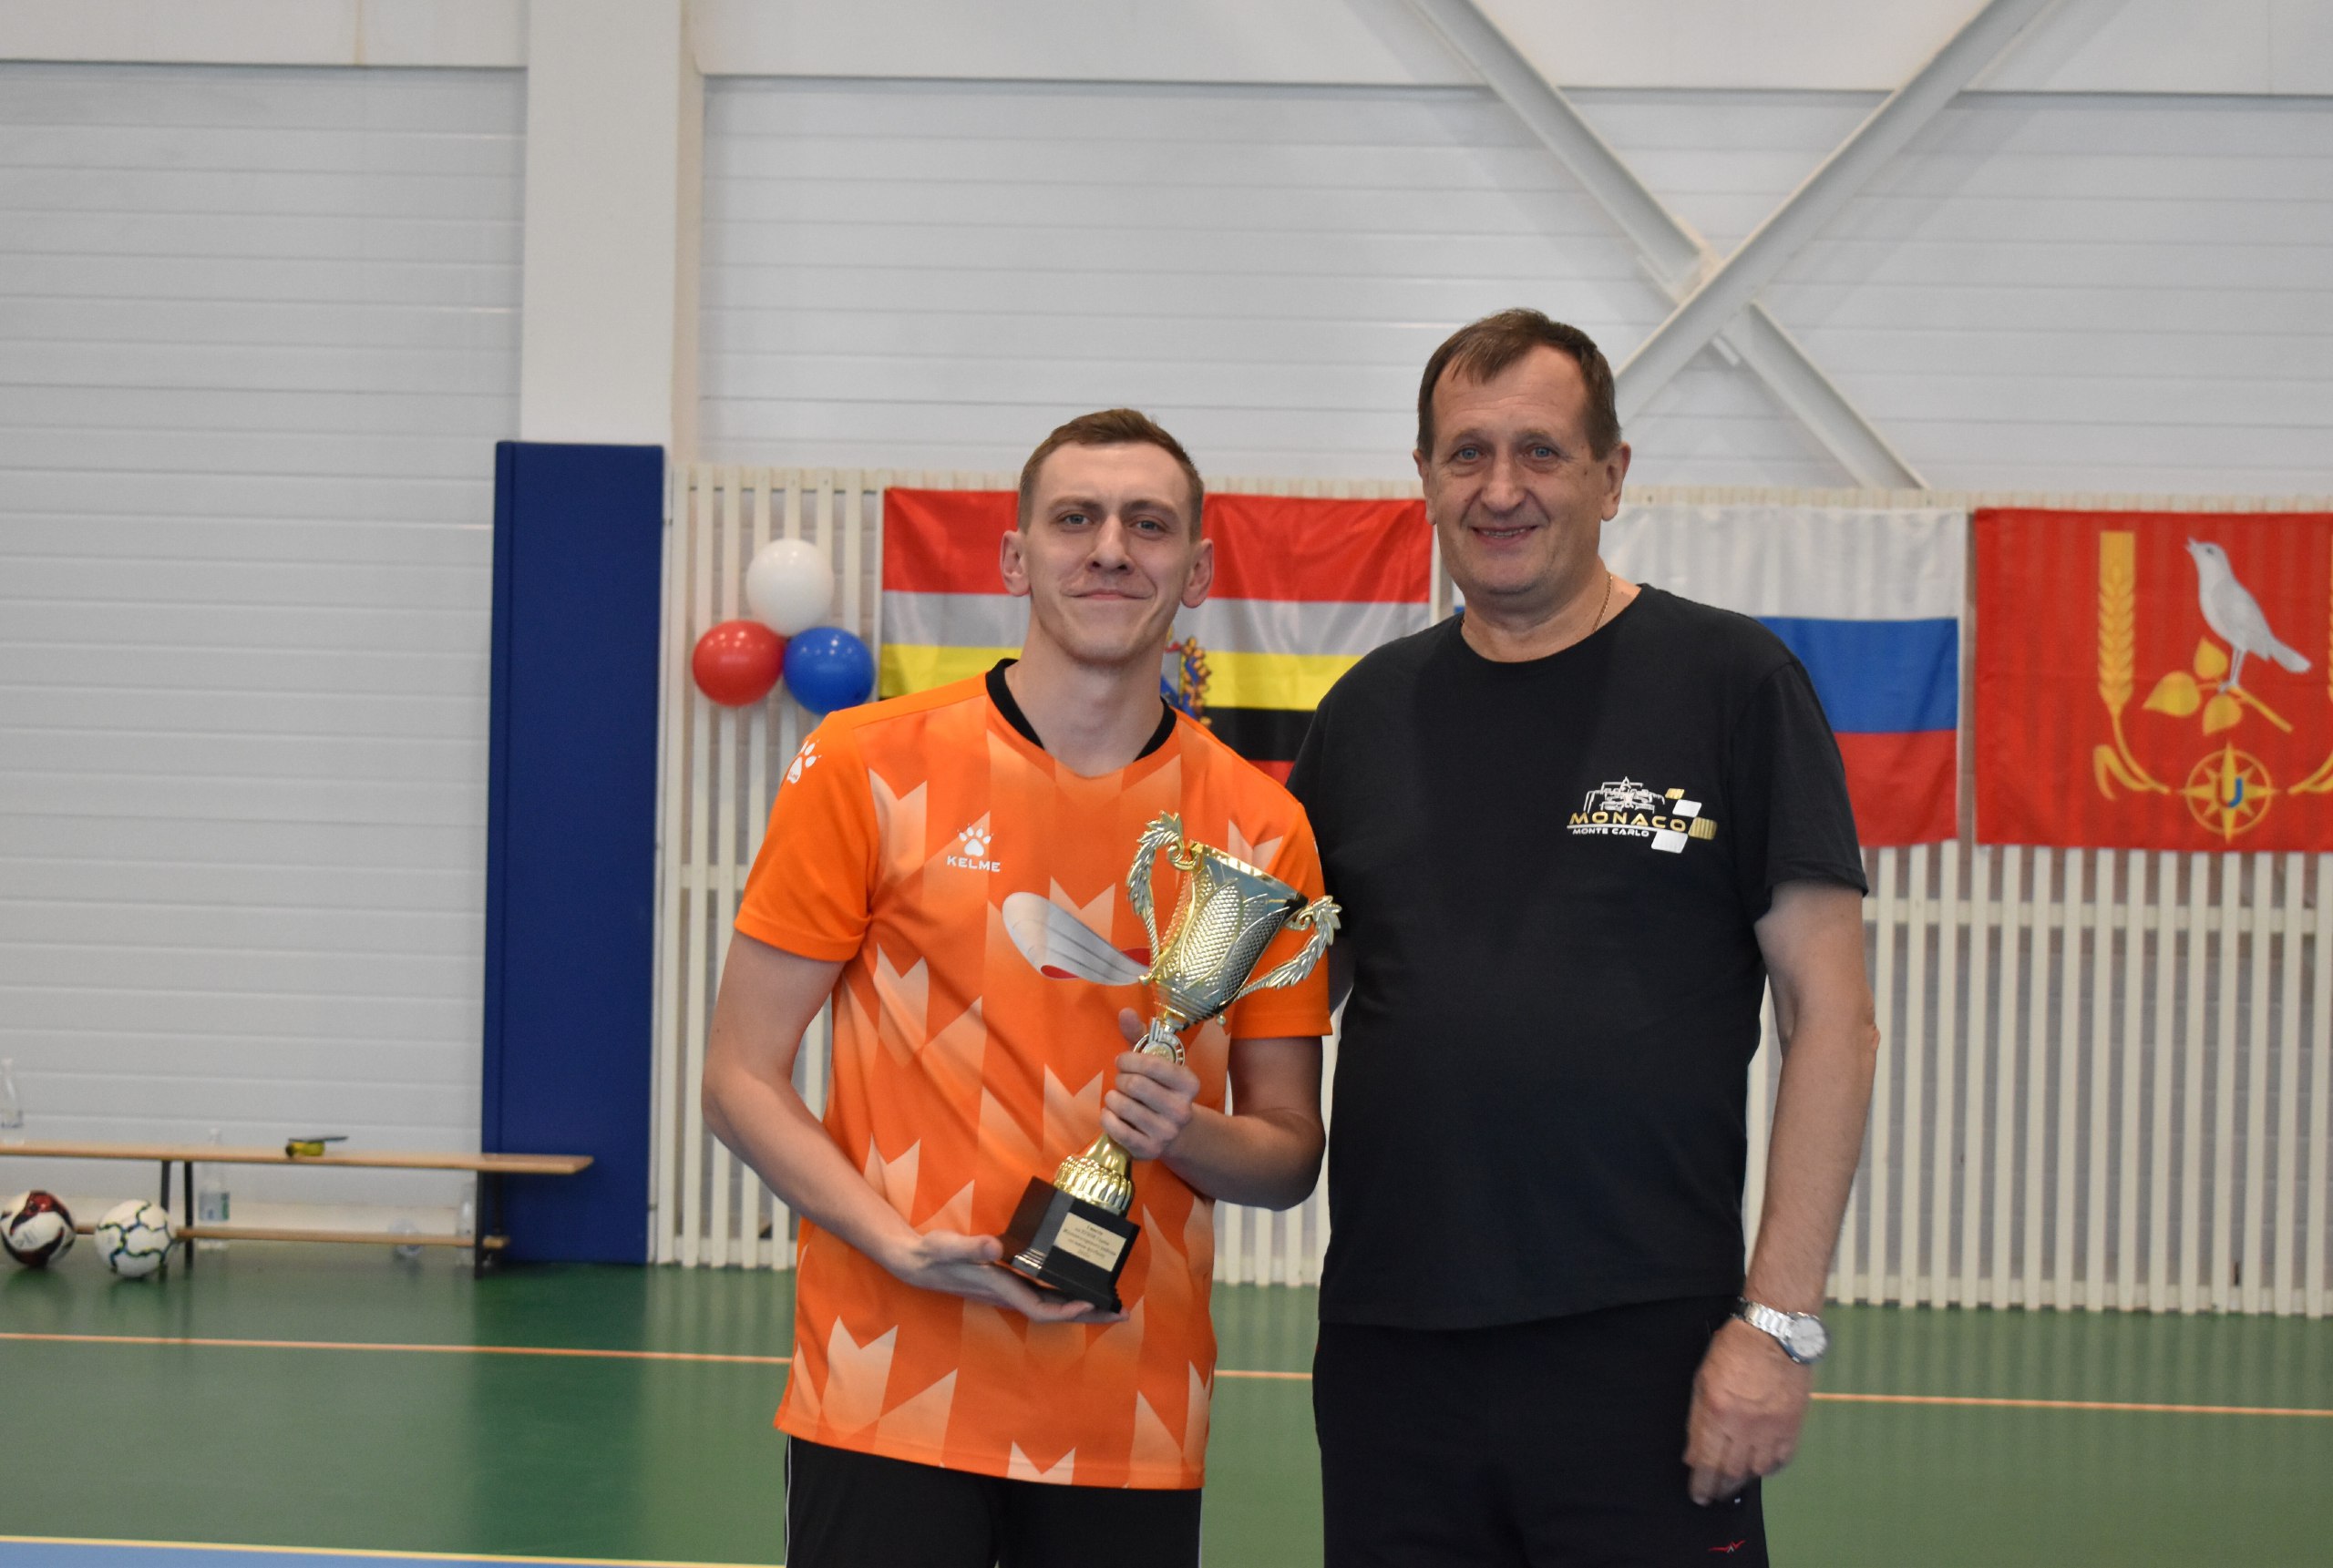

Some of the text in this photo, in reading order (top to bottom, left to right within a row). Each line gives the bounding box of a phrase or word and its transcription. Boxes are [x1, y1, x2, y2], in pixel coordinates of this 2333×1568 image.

[1570, 812, 1686, 832] MONACO
[1572, 827, 1650, 837] MONTE CARLO
[947, 856, 1001, 872] KELME
